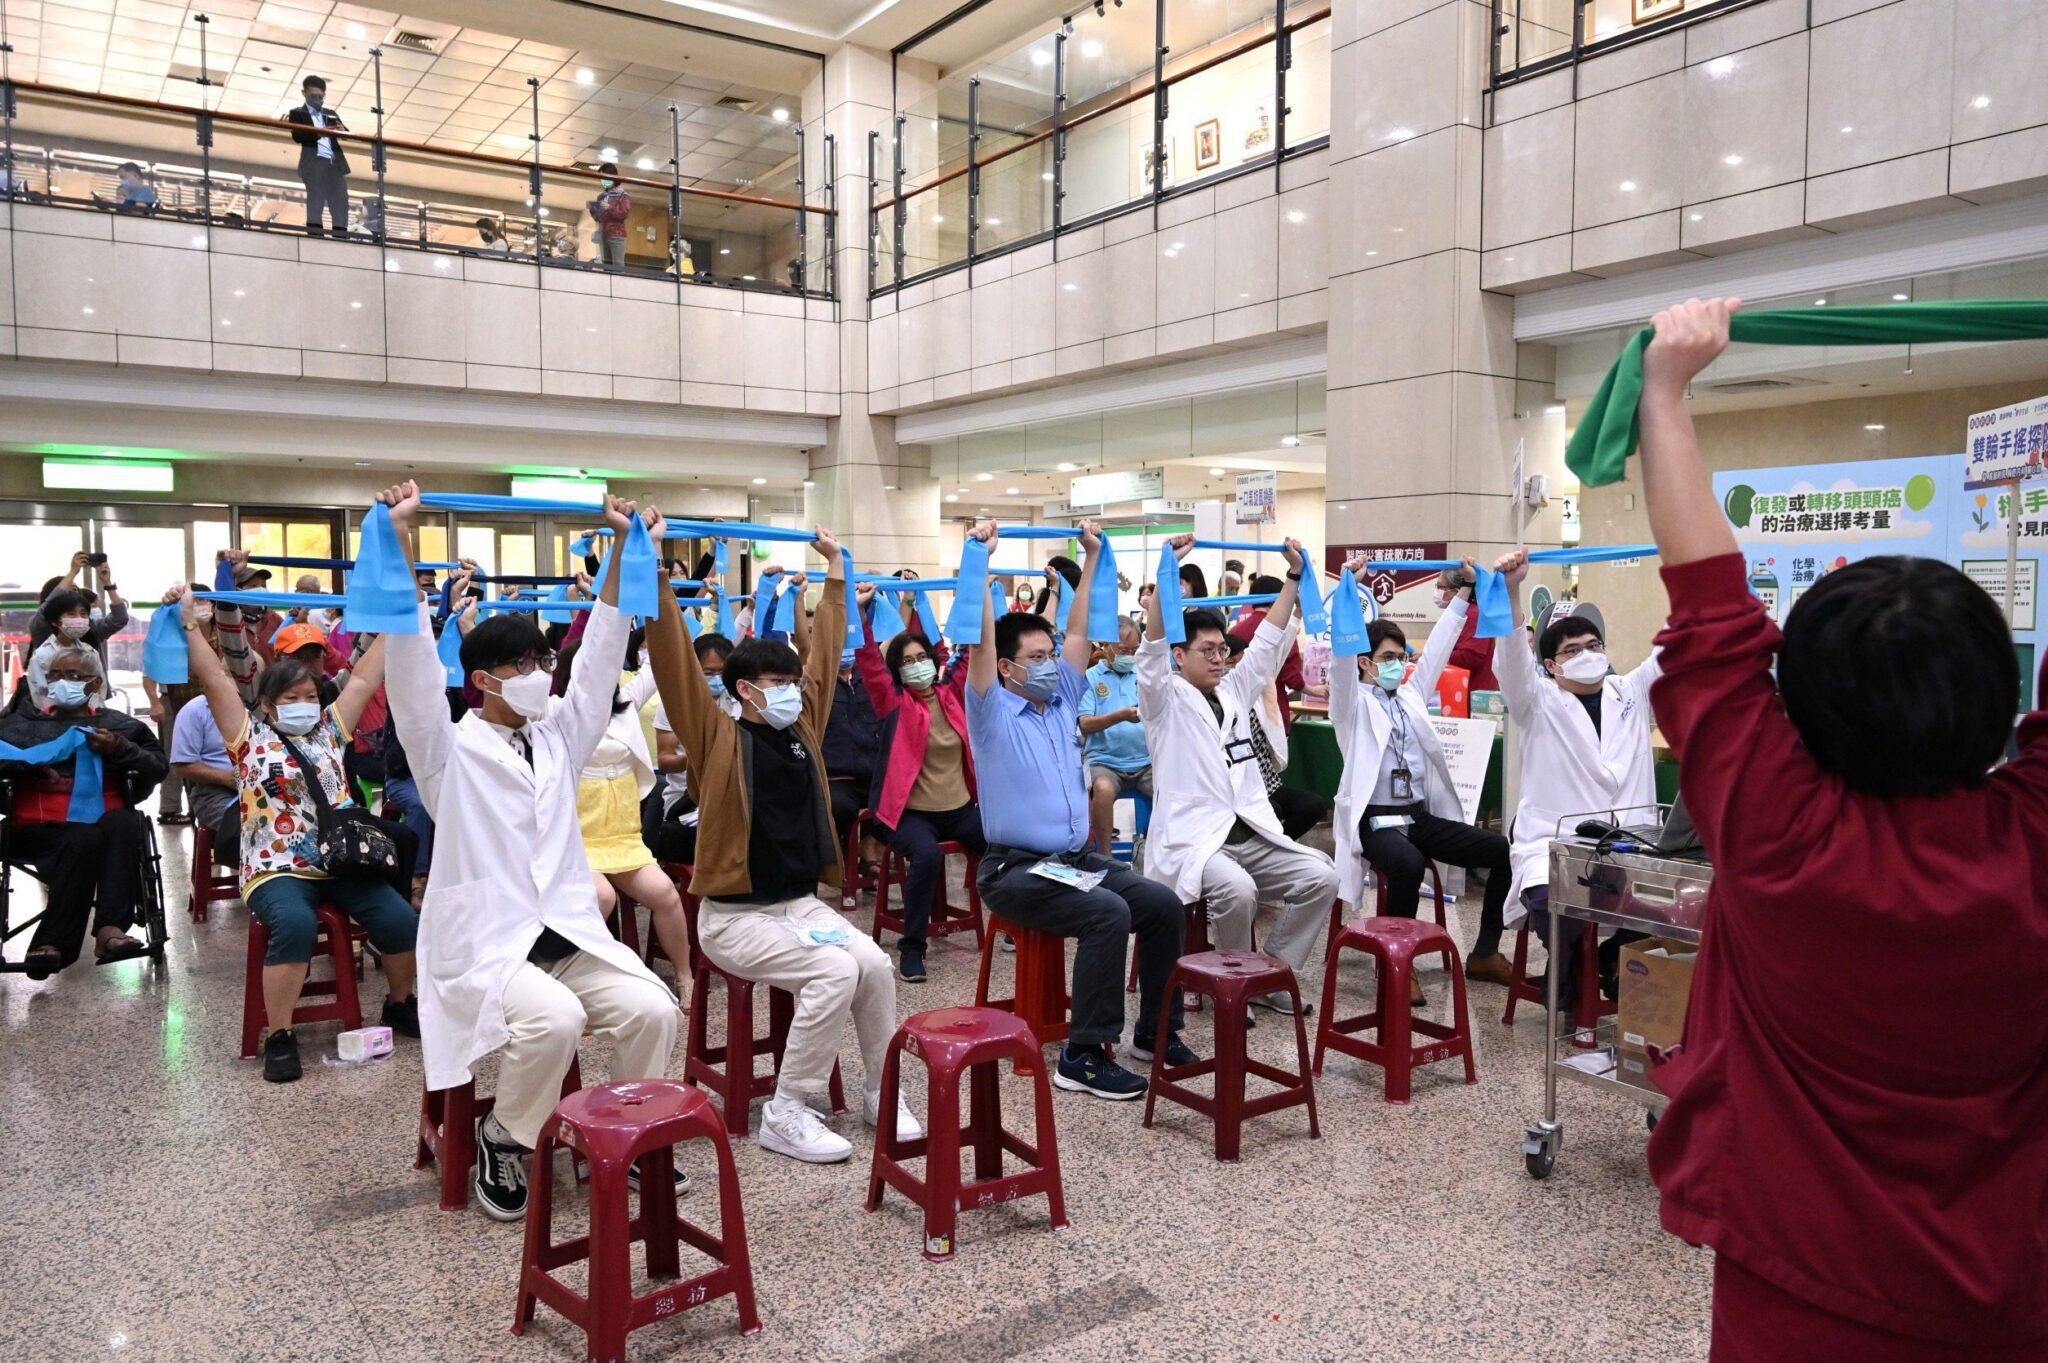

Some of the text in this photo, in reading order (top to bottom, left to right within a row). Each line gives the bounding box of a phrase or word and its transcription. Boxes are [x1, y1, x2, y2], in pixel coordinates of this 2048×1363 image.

[1753, 488, 1902, 516] 復發或轉移頭頸癌
[1761, 510, 1892, 533] 的治療選擇考量
[1792, 558, 1815, 570] 化學
[1792, 570, 1815, 582] 治療
